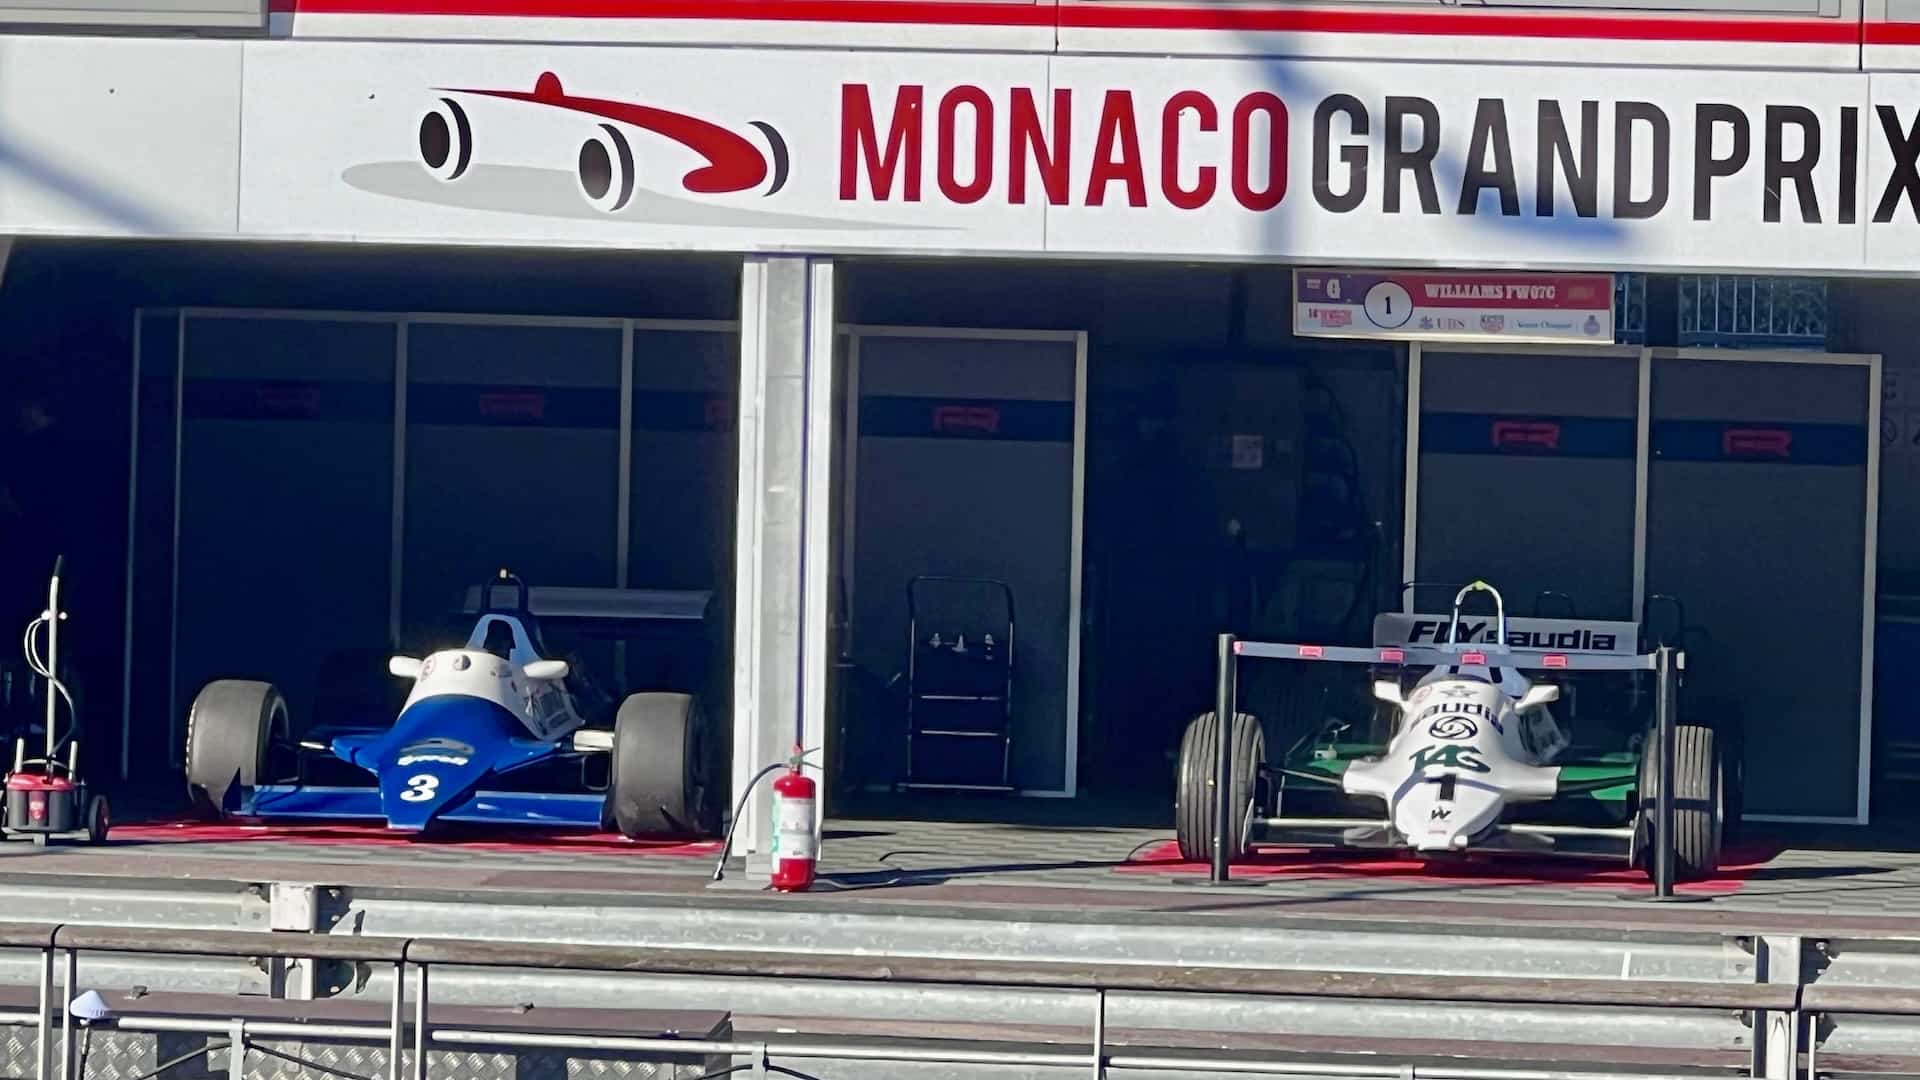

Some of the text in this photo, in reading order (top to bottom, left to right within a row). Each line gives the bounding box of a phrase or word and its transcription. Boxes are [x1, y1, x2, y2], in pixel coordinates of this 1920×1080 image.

[839, 83, 1920, 225] MONACO GRAND PRIX
[1384, 295, 1392, 315] 1
[1424, 283, 1504, 299] WILLIAMS
[400, 774, 440, 802] 3
[1436, 773, 1457, 801] 1
